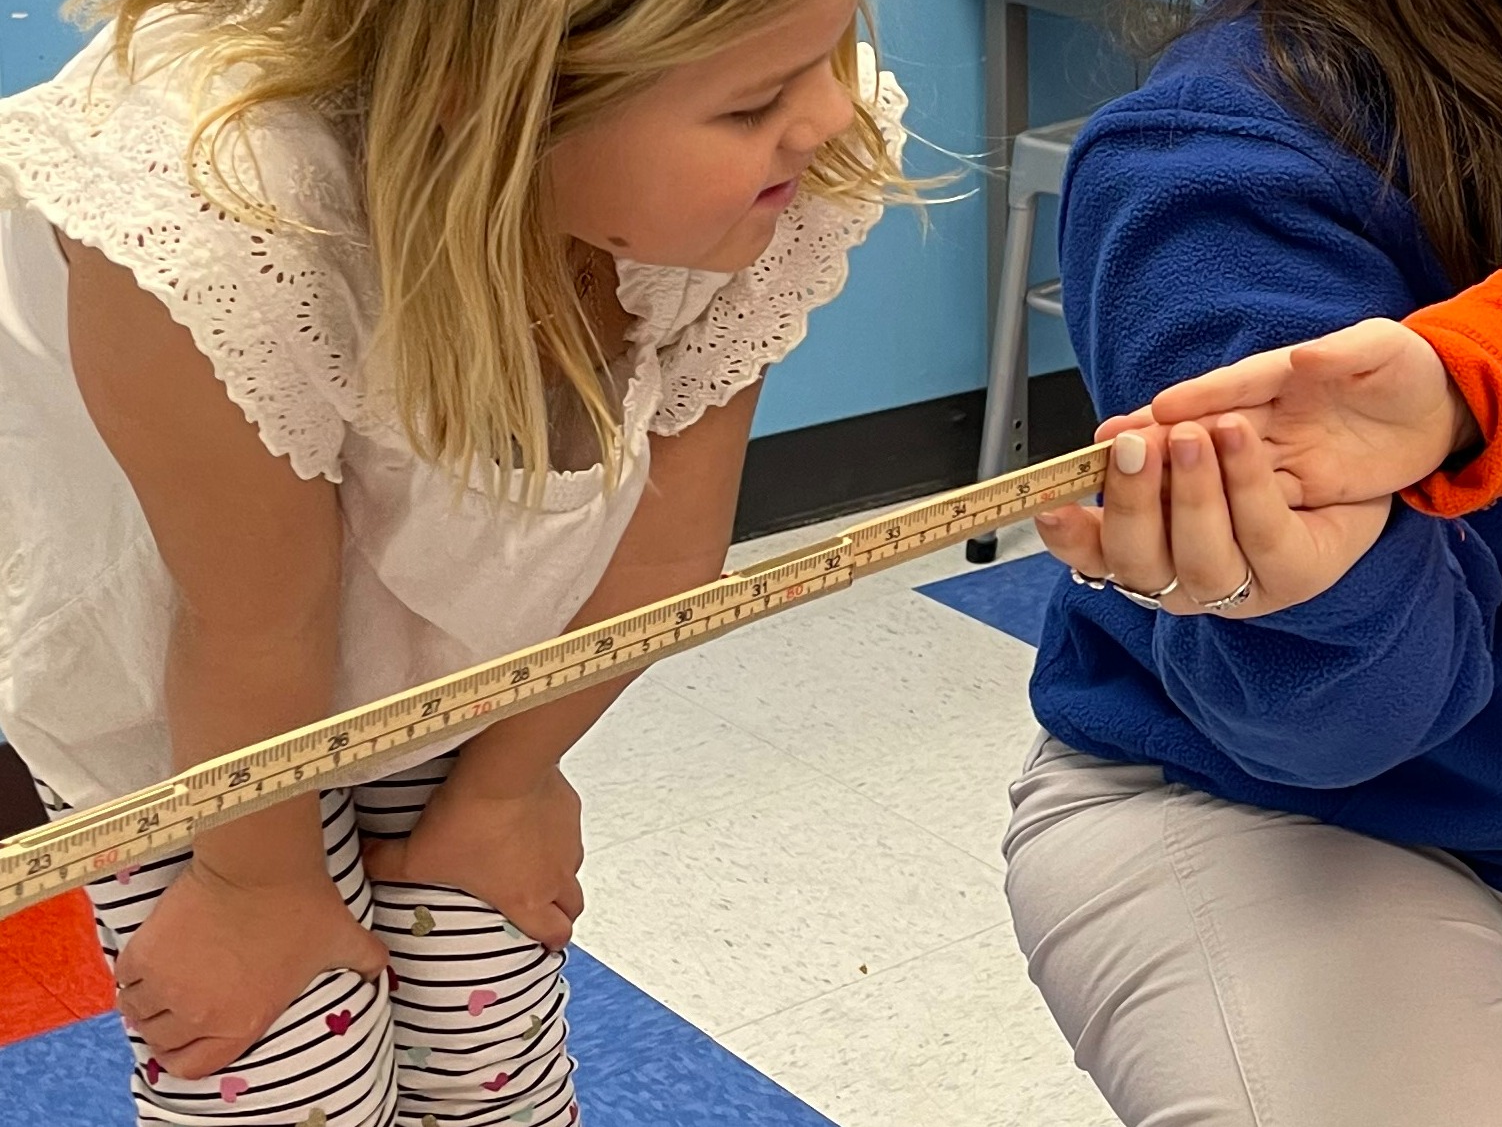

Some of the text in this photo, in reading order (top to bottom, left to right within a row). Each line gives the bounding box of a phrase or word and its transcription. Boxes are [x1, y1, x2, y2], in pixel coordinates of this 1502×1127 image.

[26, 853, 52, 876] 23
[136, 813, 160, 834] 24
[228, 767, 252, 788] 25
[326, 732, 350, 752] 26
[421, 698, 442, 718] 27
[510, 666, 531, 685] 28
[594, 636, 614, 655] 29
[675, 607, 694, 625] 30
[752, 580, 769, 598] 31
[824, 554, 842, 571] 32
[884, 525, 901, 542] 33
[951, 500, 967, 519] 34
[93, 849, 118, 870] 60
[471, 700, 493, 718] 70
[785, 584, 804, 601] 80
